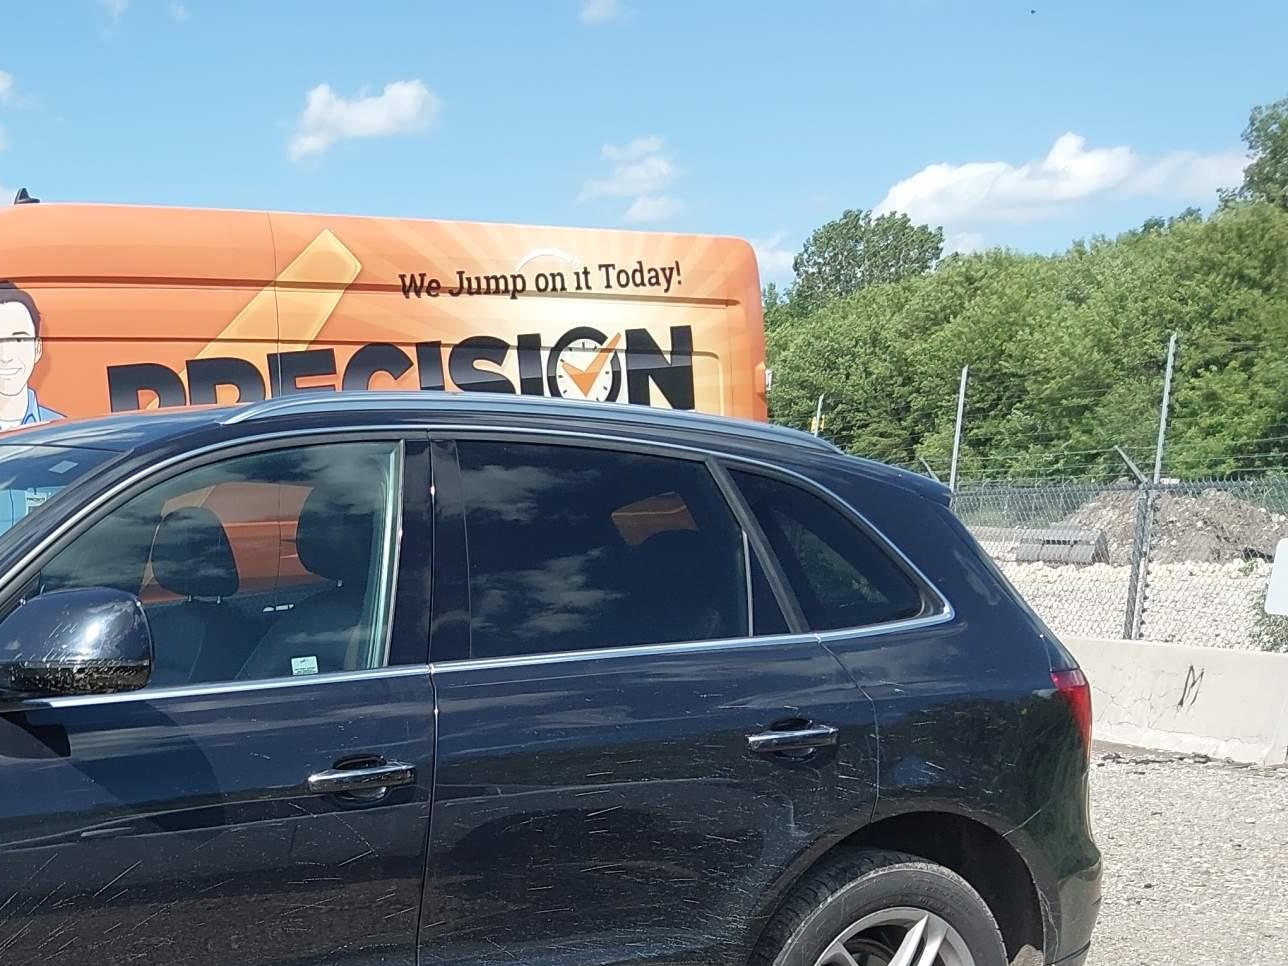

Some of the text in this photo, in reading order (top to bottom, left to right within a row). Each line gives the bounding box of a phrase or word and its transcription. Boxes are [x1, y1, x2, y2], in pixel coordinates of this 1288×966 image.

[398, 260, 682, 300] We Jump on it Today!
